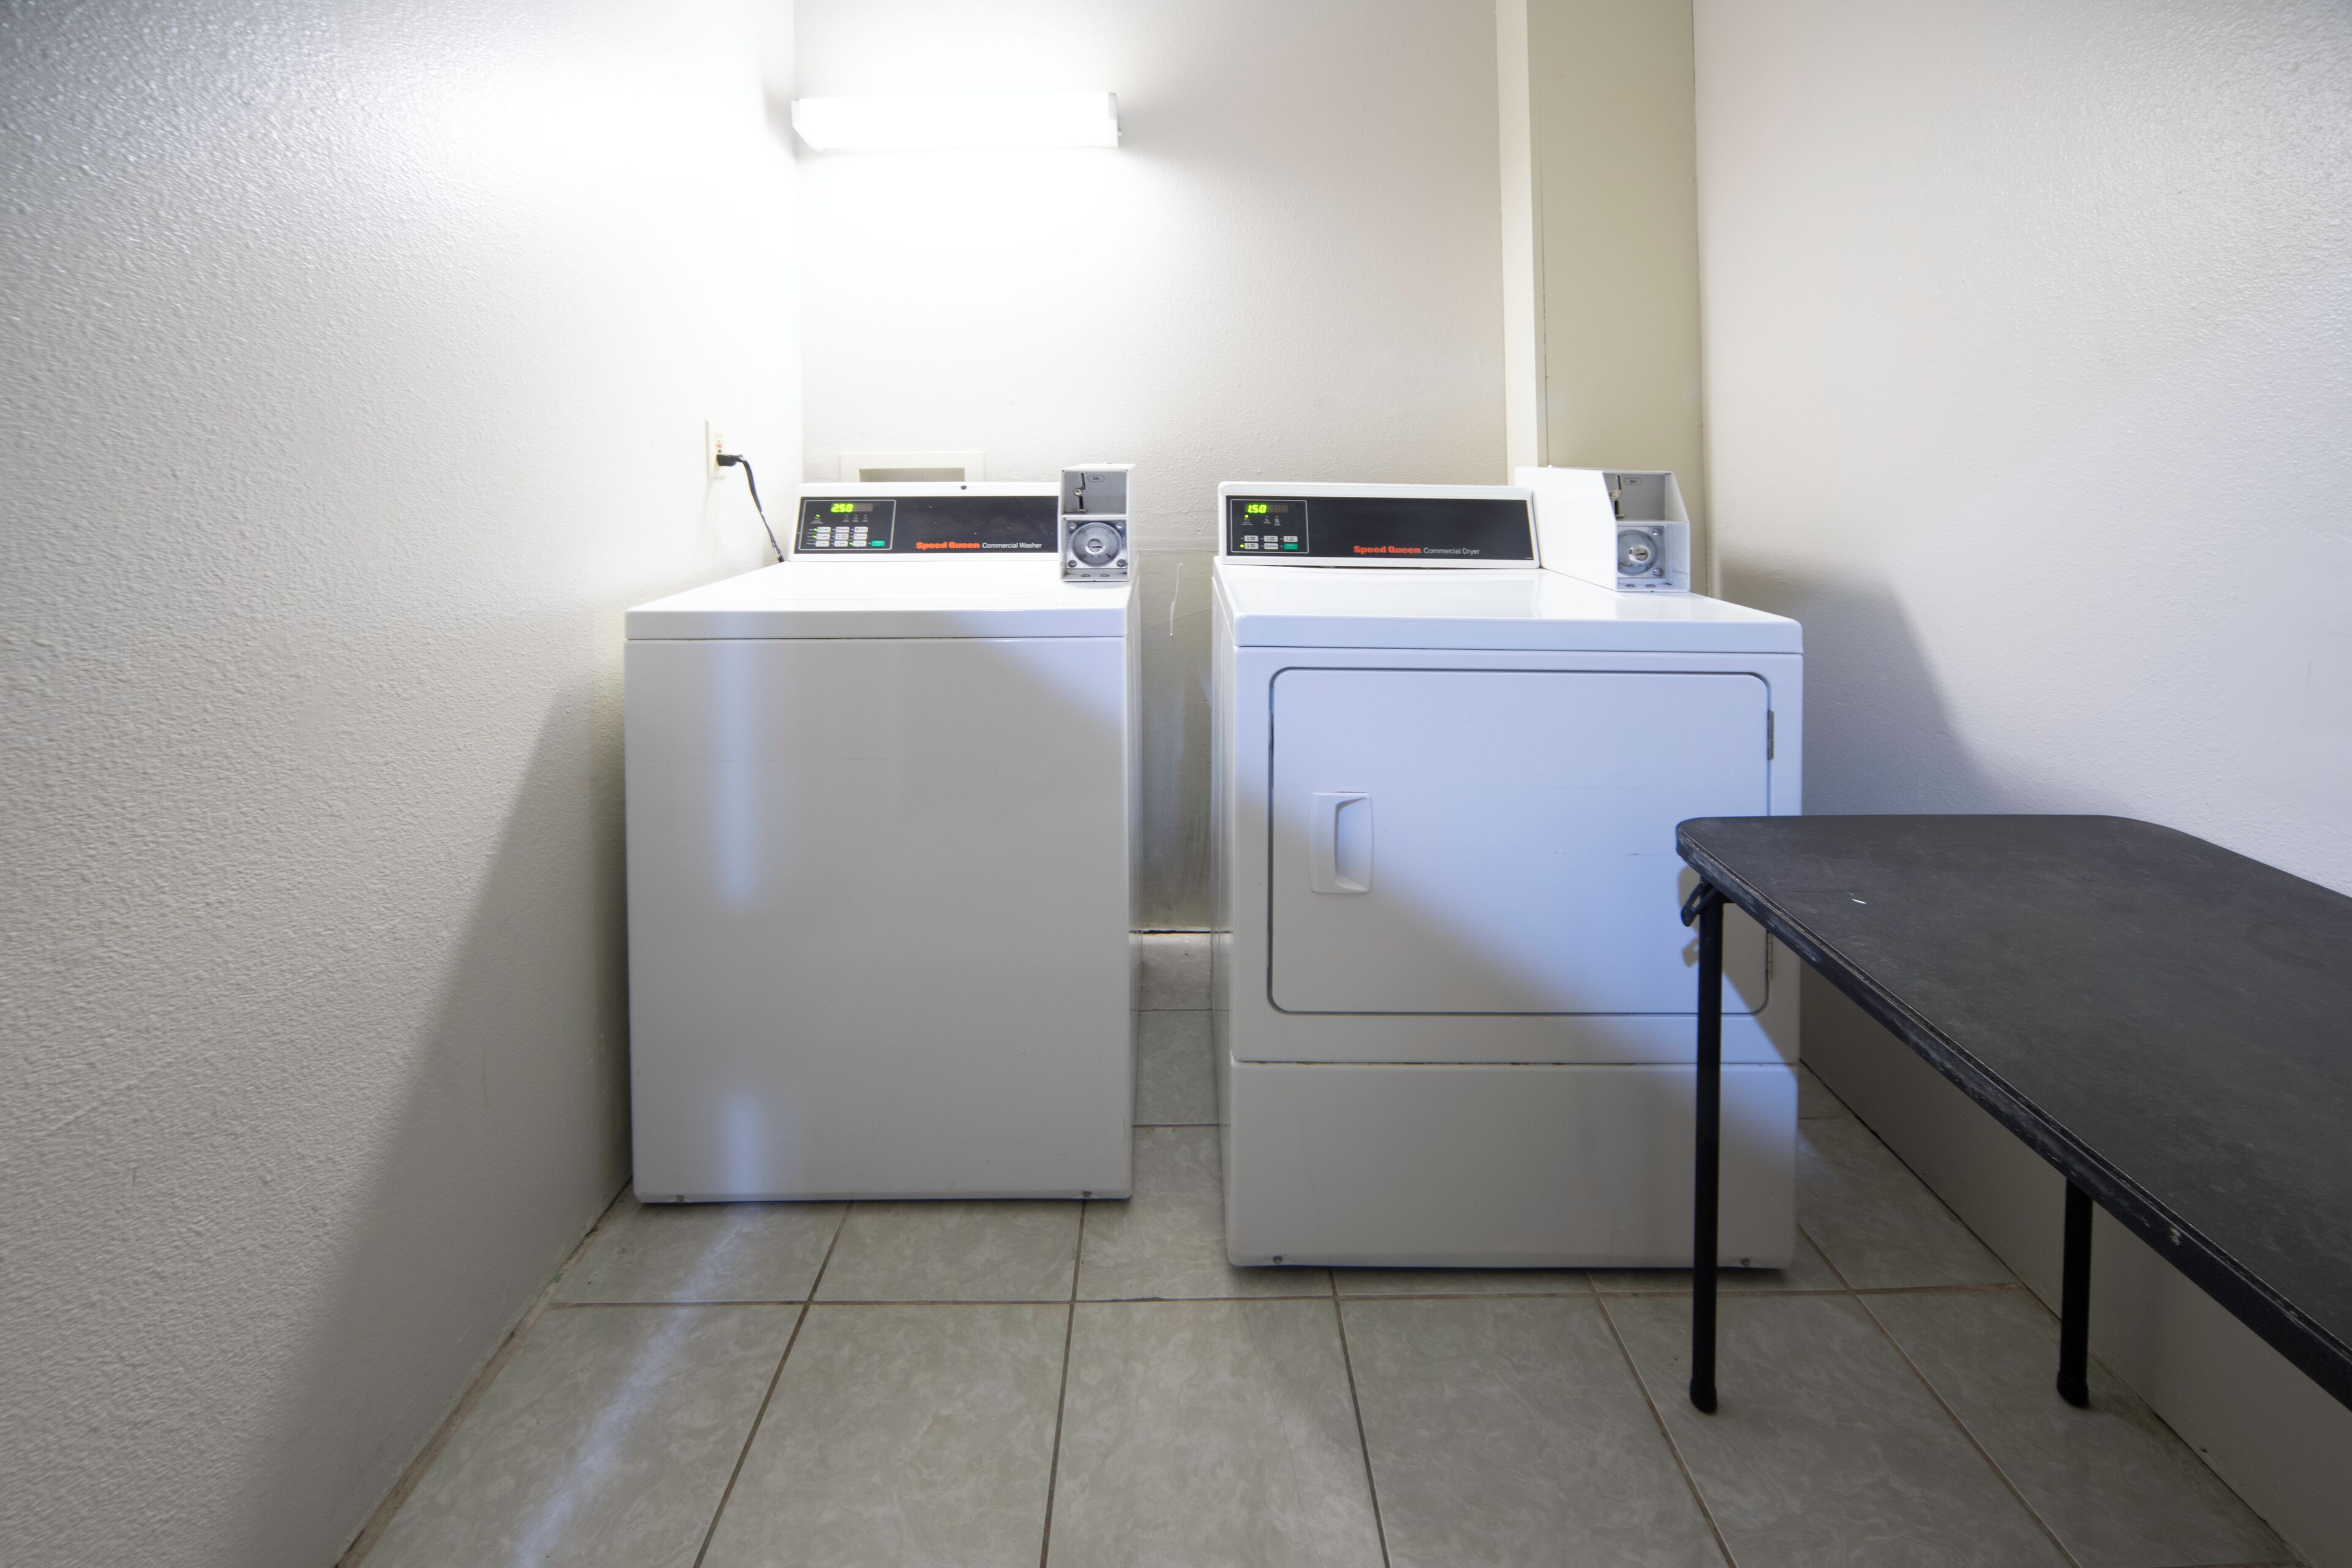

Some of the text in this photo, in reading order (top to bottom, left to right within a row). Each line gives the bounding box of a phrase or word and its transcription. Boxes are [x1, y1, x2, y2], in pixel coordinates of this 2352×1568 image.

[831, 503, 853, 512] 2.50
[1247, 504, 1267, 513] 1.50
[916, 541, 947, 550] Speed
[1354, 545, 1385, 554] Speed
